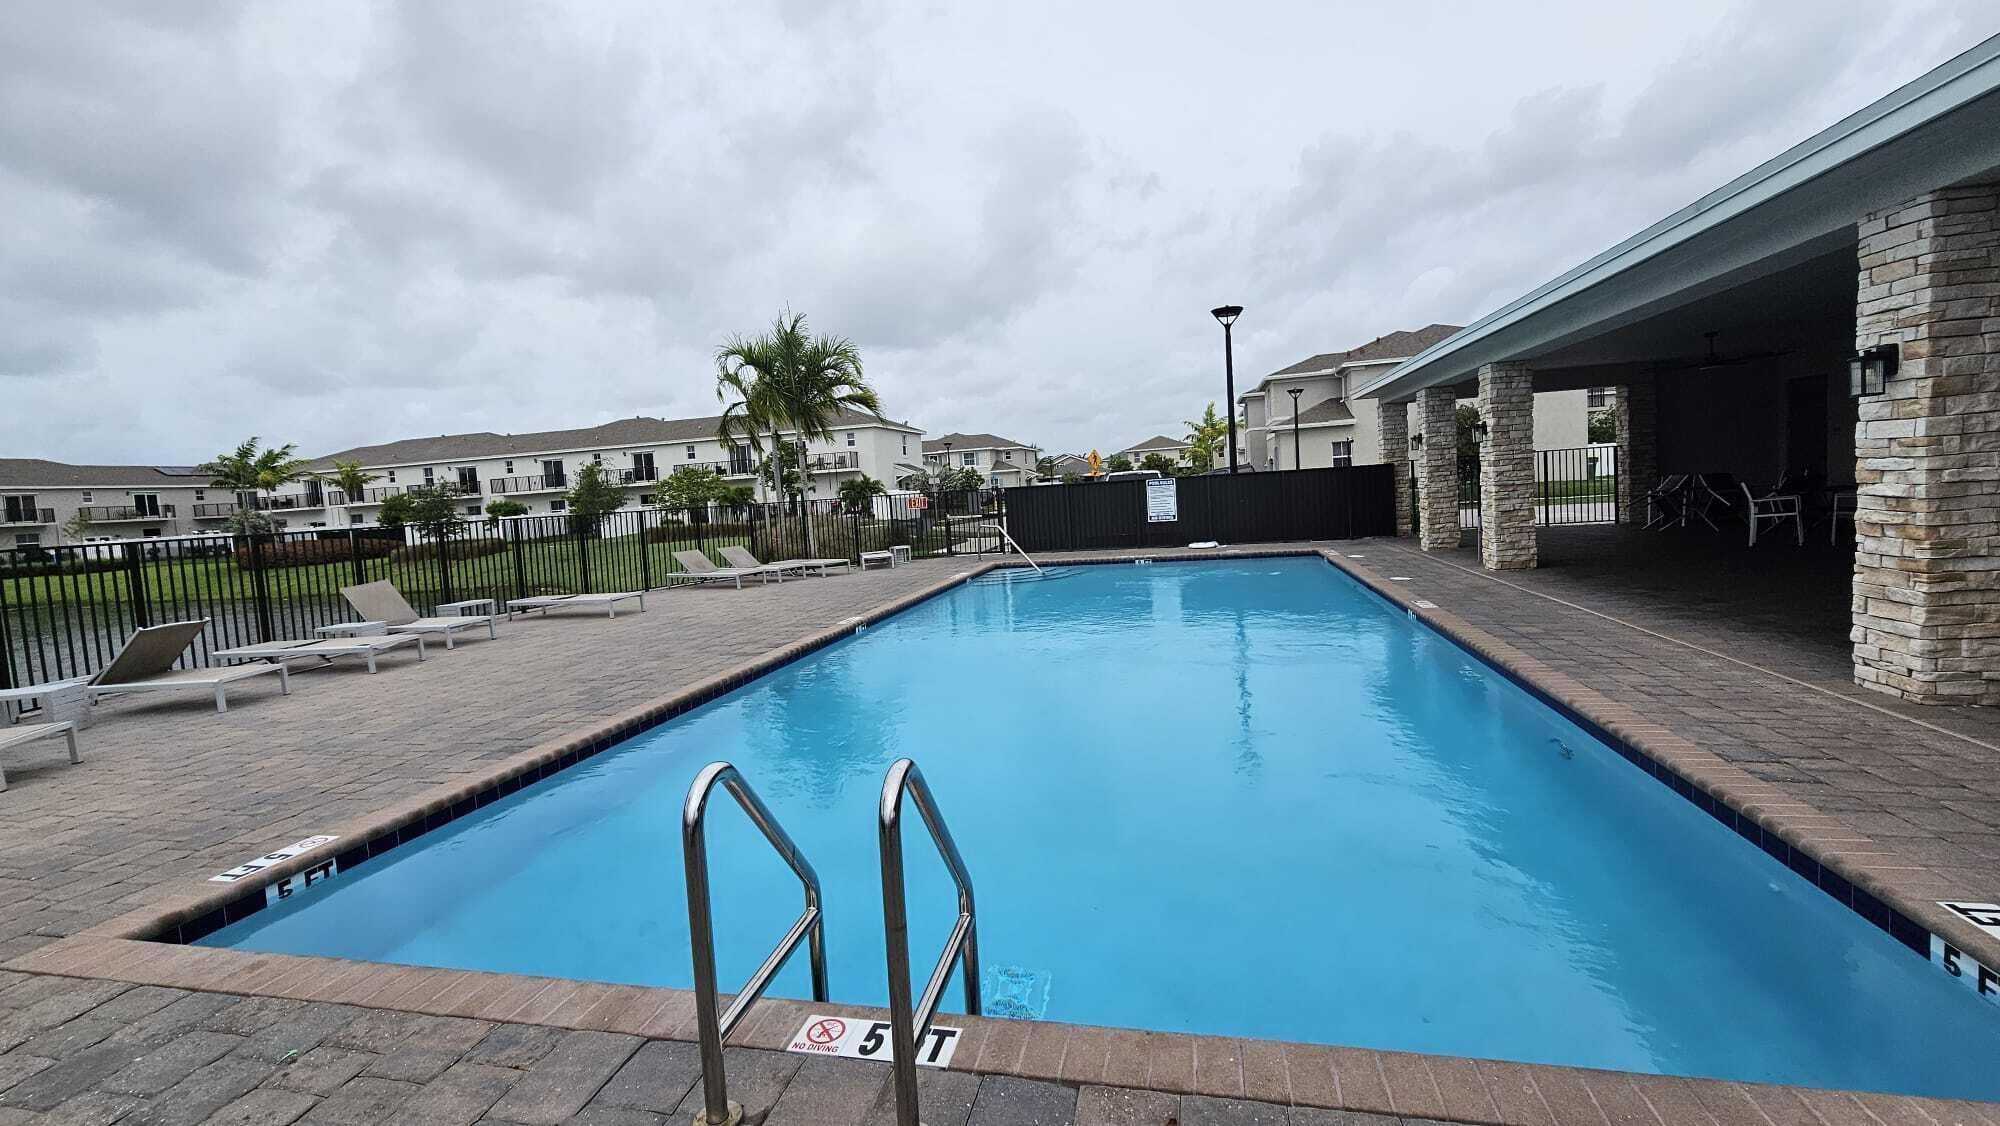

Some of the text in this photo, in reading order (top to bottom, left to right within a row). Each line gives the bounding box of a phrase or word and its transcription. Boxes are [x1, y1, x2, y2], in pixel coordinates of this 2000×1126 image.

[277, 860, 334, 900] 5 FT
[1943, 941, 2000, 997] 5 F
[791, 1041, 840, 1053] NO DIVING
[858, 1022, 892, 1056] 5
